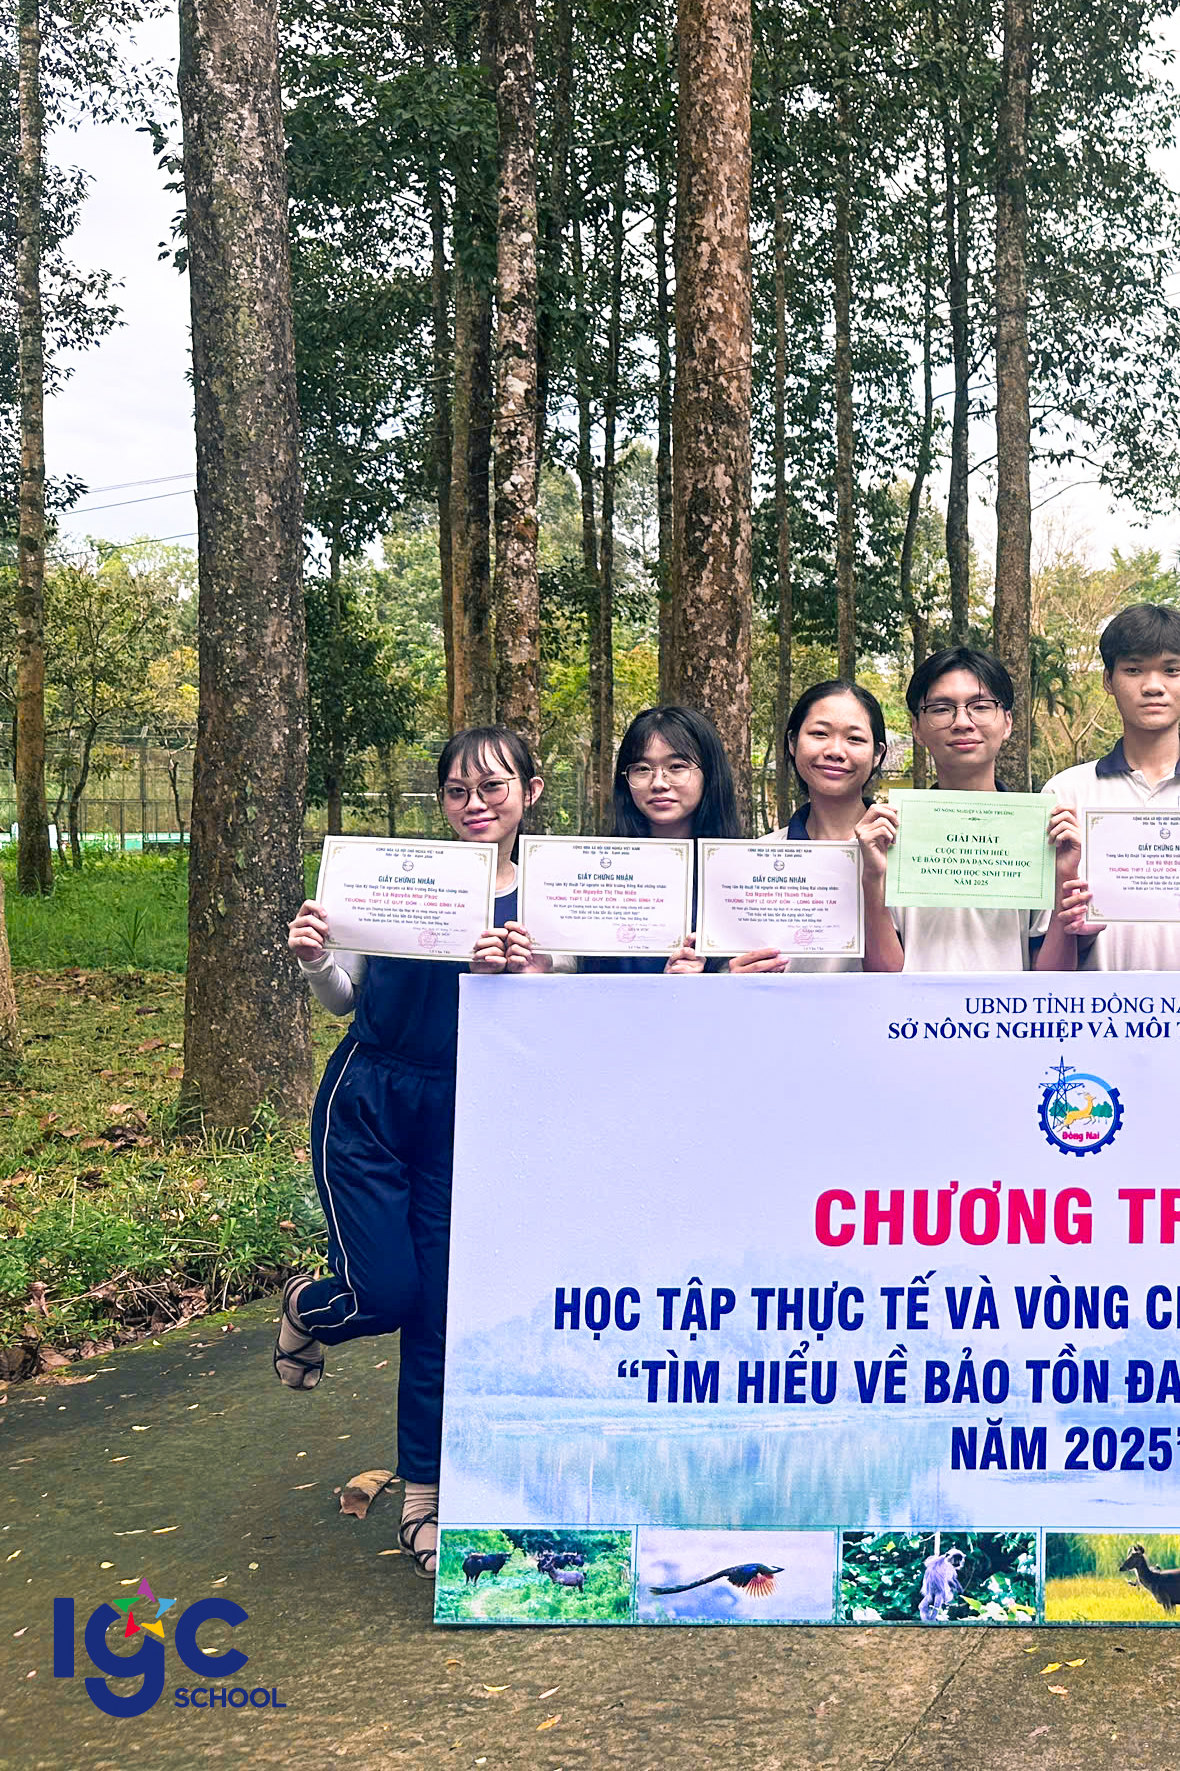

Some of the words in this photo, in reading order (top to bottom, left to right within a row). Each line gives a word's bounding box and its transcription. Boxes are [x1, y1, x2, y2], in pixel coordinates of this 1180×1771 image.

[889, 1018, 918, 1039] SỞ
[924, 1017, 989, 1038] NÔNG
[996, 1019, 1083, 1042] NGHIỆP
[1088, 1017, 1118, 1038] VÀ
[1125, 1017, 1170, 1038] MÔI
[966, 998, 1027, 1014] UBND
[1033, 993, 1084, 1013] TỈNH
[1091, 993, 1156, 1014] ĐỒNG
[816, 1181, 1092, 1246] CHƯƠNG
[555, 1287, 640, 1340] HỌC
[657, 1277, 735, 1341] TẬP
[751, 1281, 864, 1342] THỰC
[880, 1270, 936, 1330] TẾ
[945, 1275, 999, 1329] VÀ
[1014, 1275, 1128, 1330] VÒNG
[738, 1340, 837, 1404] HIỂU
[854, 1344, 908, 1403] VỀ
[925, 1347, 1009, 1404] BẢO
[1026, 1343, 1109, 1404] TỒN
[951, 1417, 1047, 1470] NĂM
